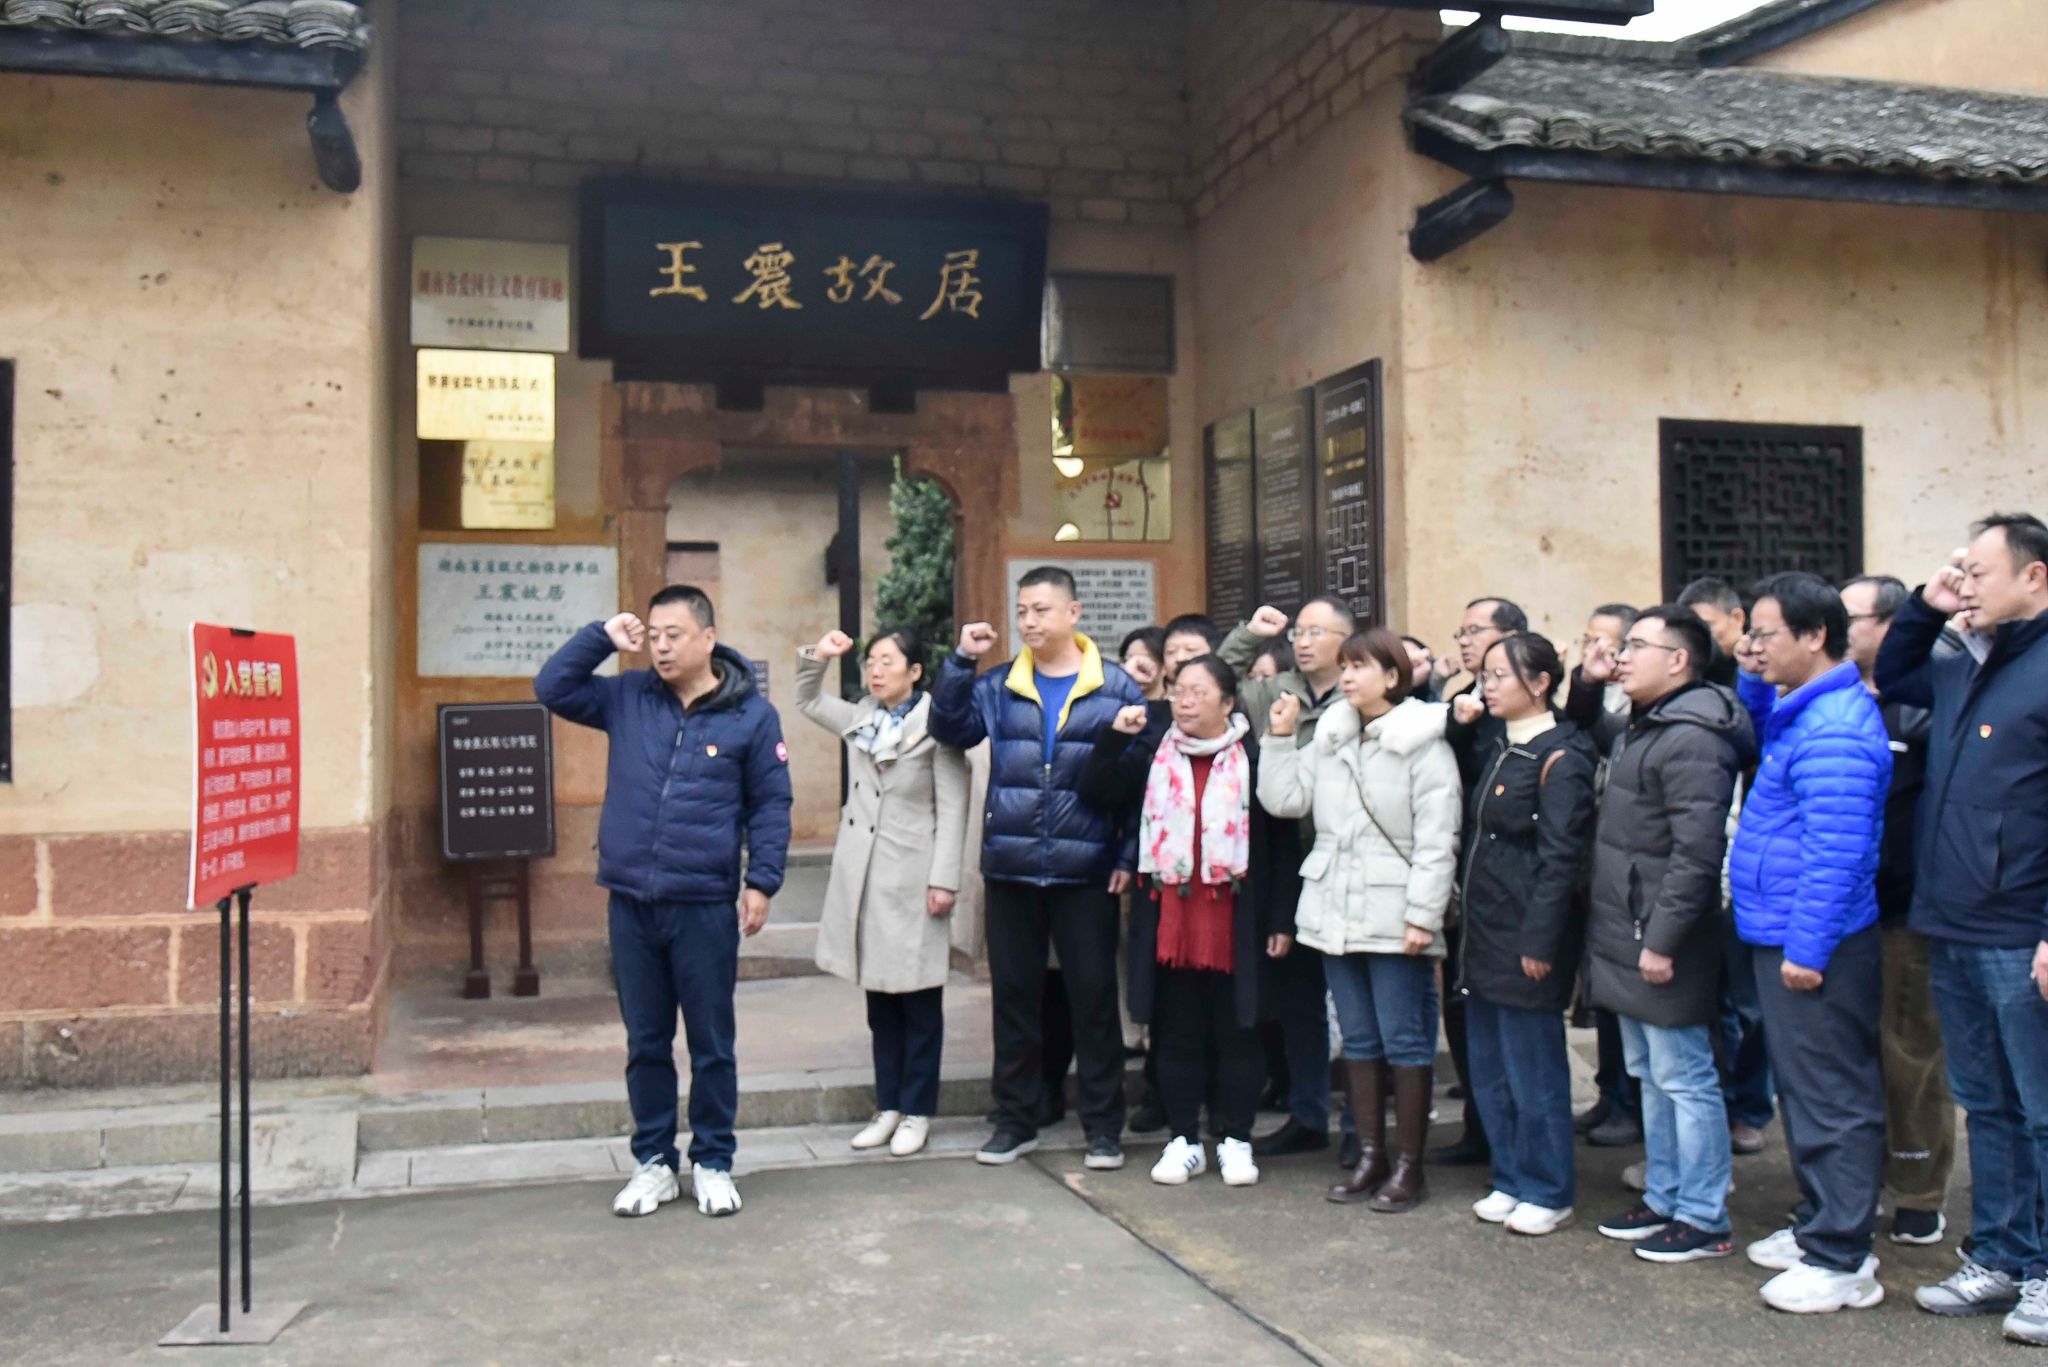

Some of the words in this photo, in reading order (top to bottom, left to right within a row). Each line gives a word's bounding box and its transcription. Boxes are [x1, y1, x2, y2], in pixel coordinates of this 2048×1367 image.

[649, 240, 983, 321] 王震故居
[473, 583, 566, 601] 王震故居
